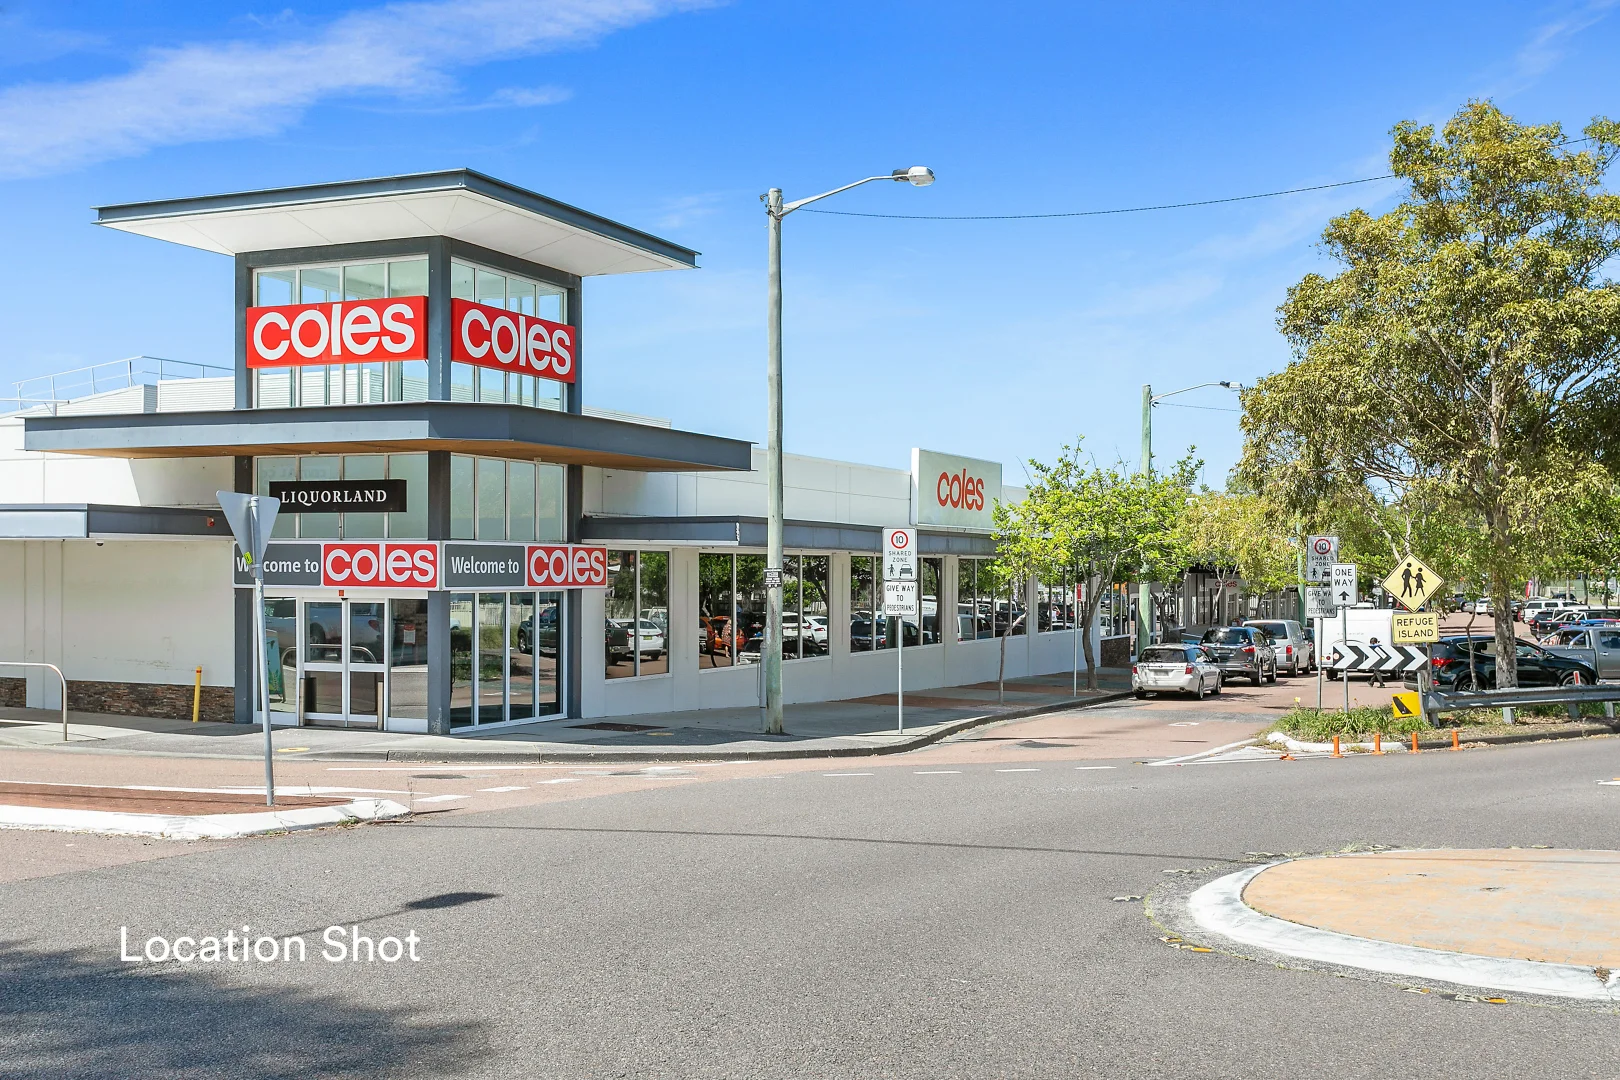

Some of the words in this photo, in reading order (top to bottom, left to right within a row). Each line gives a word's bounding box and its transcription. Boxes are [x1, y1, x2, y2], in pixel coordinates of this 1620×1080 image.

[253, 303, 416, 361] coles
[461, 308, 572, 375] coles
[937, 468, 984, 511] coles
[281, 489, 388, 506] LIQUORLAND
[895, 535, 904, 544] 10
[1318, 542, 1327, 551] 10
[305, 558, 319, 573] to
[325, 544, 435, 583] coles
[451, 556, 506, 574] Welcome
[508, 558, 520, 574] to
[530, 546, 604, 584] coles
[1334, 568, 1353, 577] ONE
[1333, 578, 1354, 587] WAY
[886, 584, 900, 592] GIVE
[901, 584, 915, 592] WAY
[896, 594, 904, 602] TO
[886, 604, 915, 612] PEDESTRIANS
[1308, 607, 1335, 615] PEDESTRIANS
[1396, 617, 1434, 627] REFUGE
[1398, 628, 1434, 638] ISLAND
